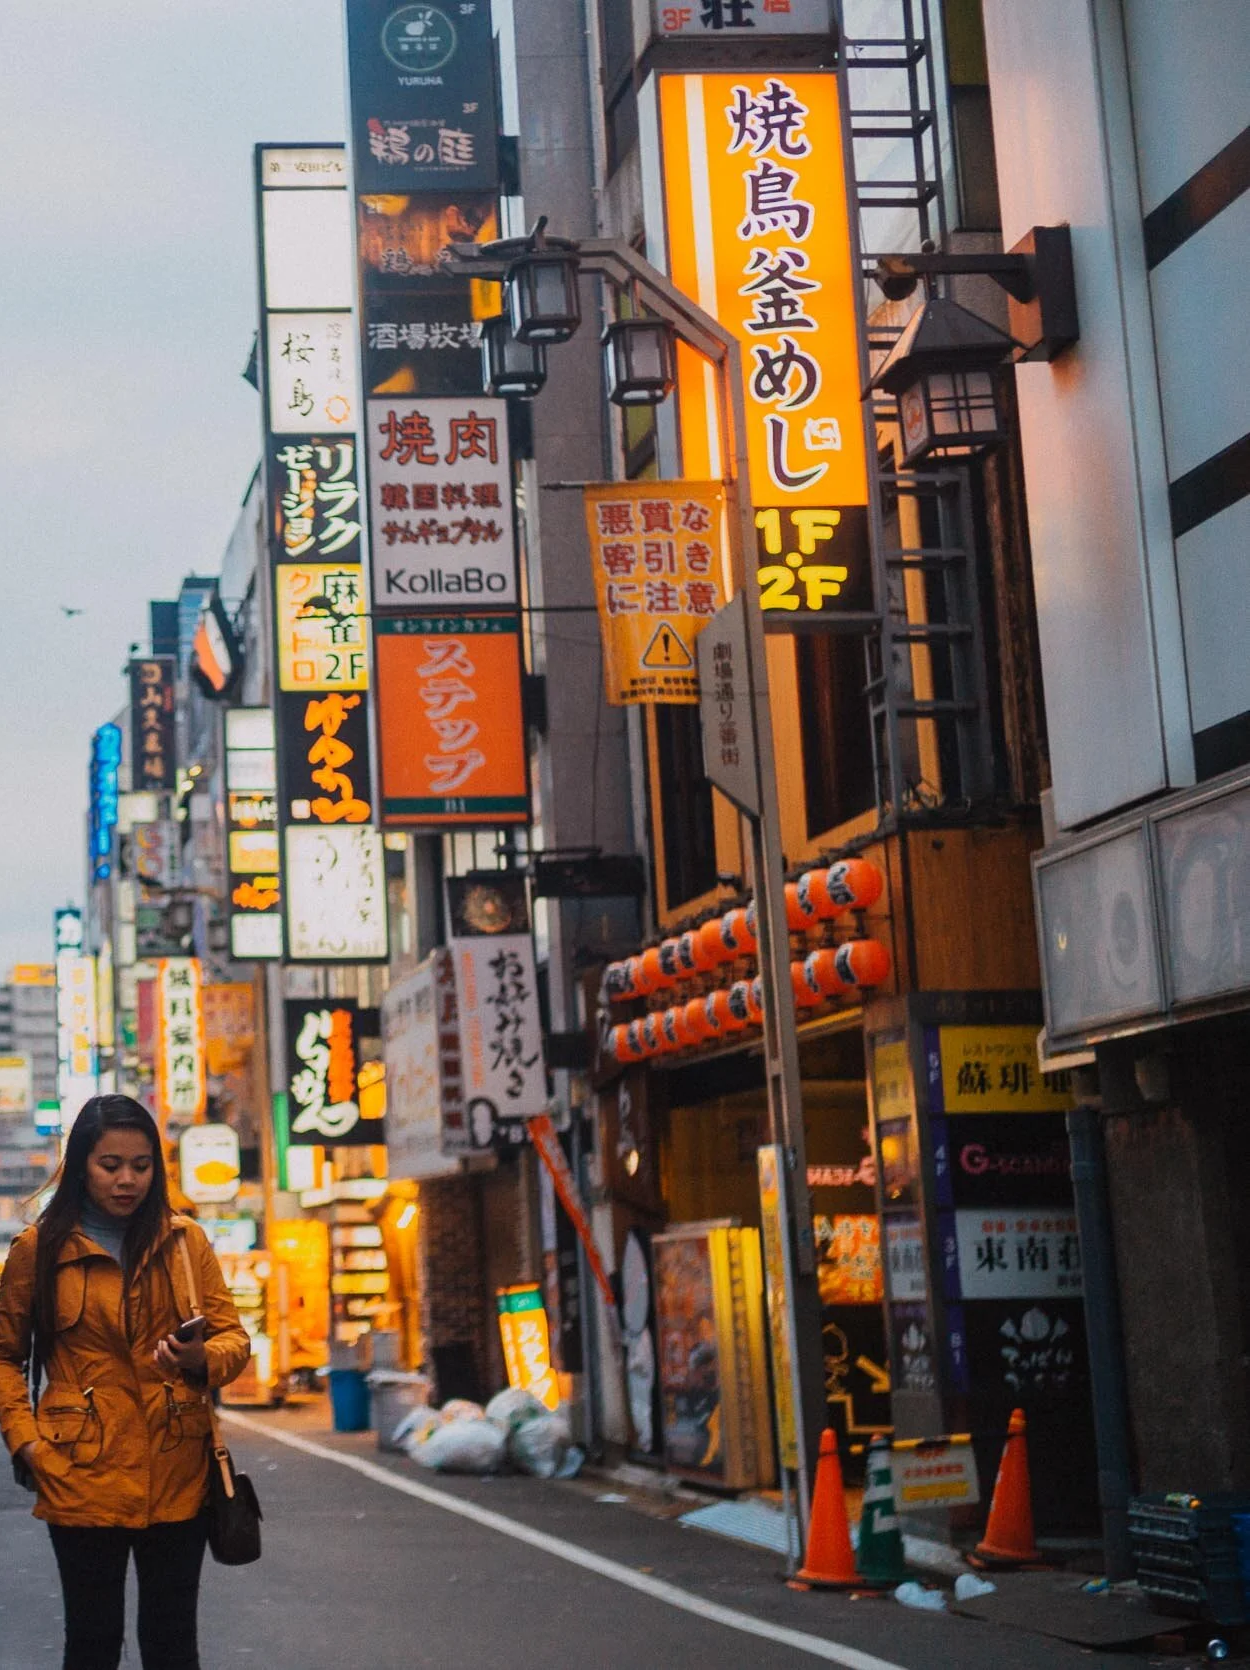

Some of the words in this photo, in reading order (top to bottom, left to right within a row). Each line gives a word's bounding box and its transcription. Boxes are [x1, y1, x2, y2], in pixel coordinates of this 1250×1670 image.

[459, 4, 476, 15] 3F
[662, 8, 692, 31] 3F
[398, 76, 444, 86] YURUHA
[462, 102, 479, 114] 3F
[727, 80, 828, 491] 焼鳥釜めし
[367, 322, 484, 350] 酒場牧場
[379, 410, 499, 465] 焼肉
[277, 444, 316, 557] ゼーション
[316, 443, 362, 555] リラク
[597, 501, 711, 536] 悪質な
[755, 508, 841, 554] 1F
[602, 540, 711, 577] 客引き
[385, 567, 508, 594] KollaBo
[606, 580, 718, 617] に注意
[756, 566, 848, 611] 2F
[325, 653, 364, 680] 2F
[416, 638, 486, 793] ステップ
[168, 967, 196, 1106] 無料案内所
[486, 951, 539, 1099] お好み焼き
